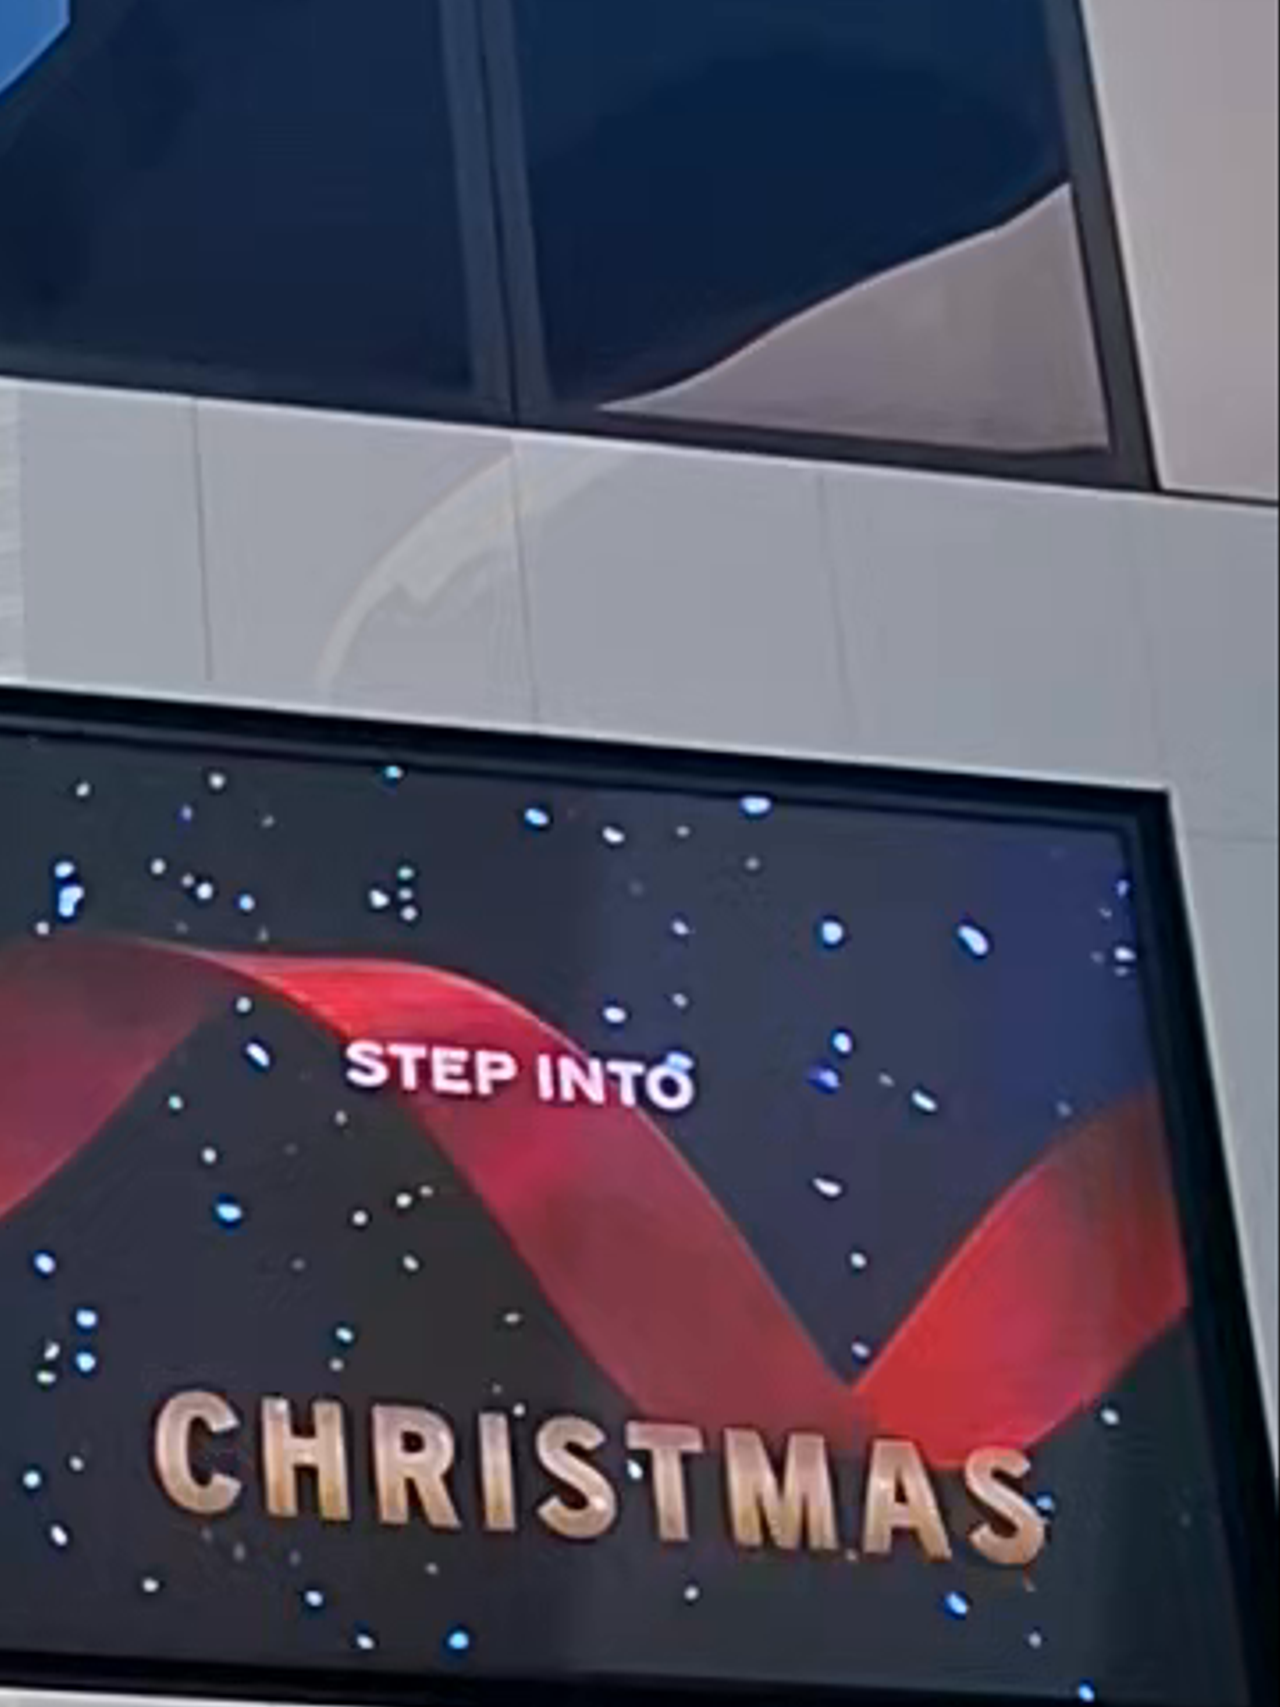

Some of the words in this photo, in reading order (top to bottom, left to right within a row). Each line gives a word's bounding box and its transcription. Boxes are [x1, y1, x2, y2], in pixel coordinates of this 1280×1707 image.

[345, 1039, 519, 1096] STEP
[537, 1052, 696, 1110] INTO
[152, 1390, 1048, 1564] CHRISTMAS
